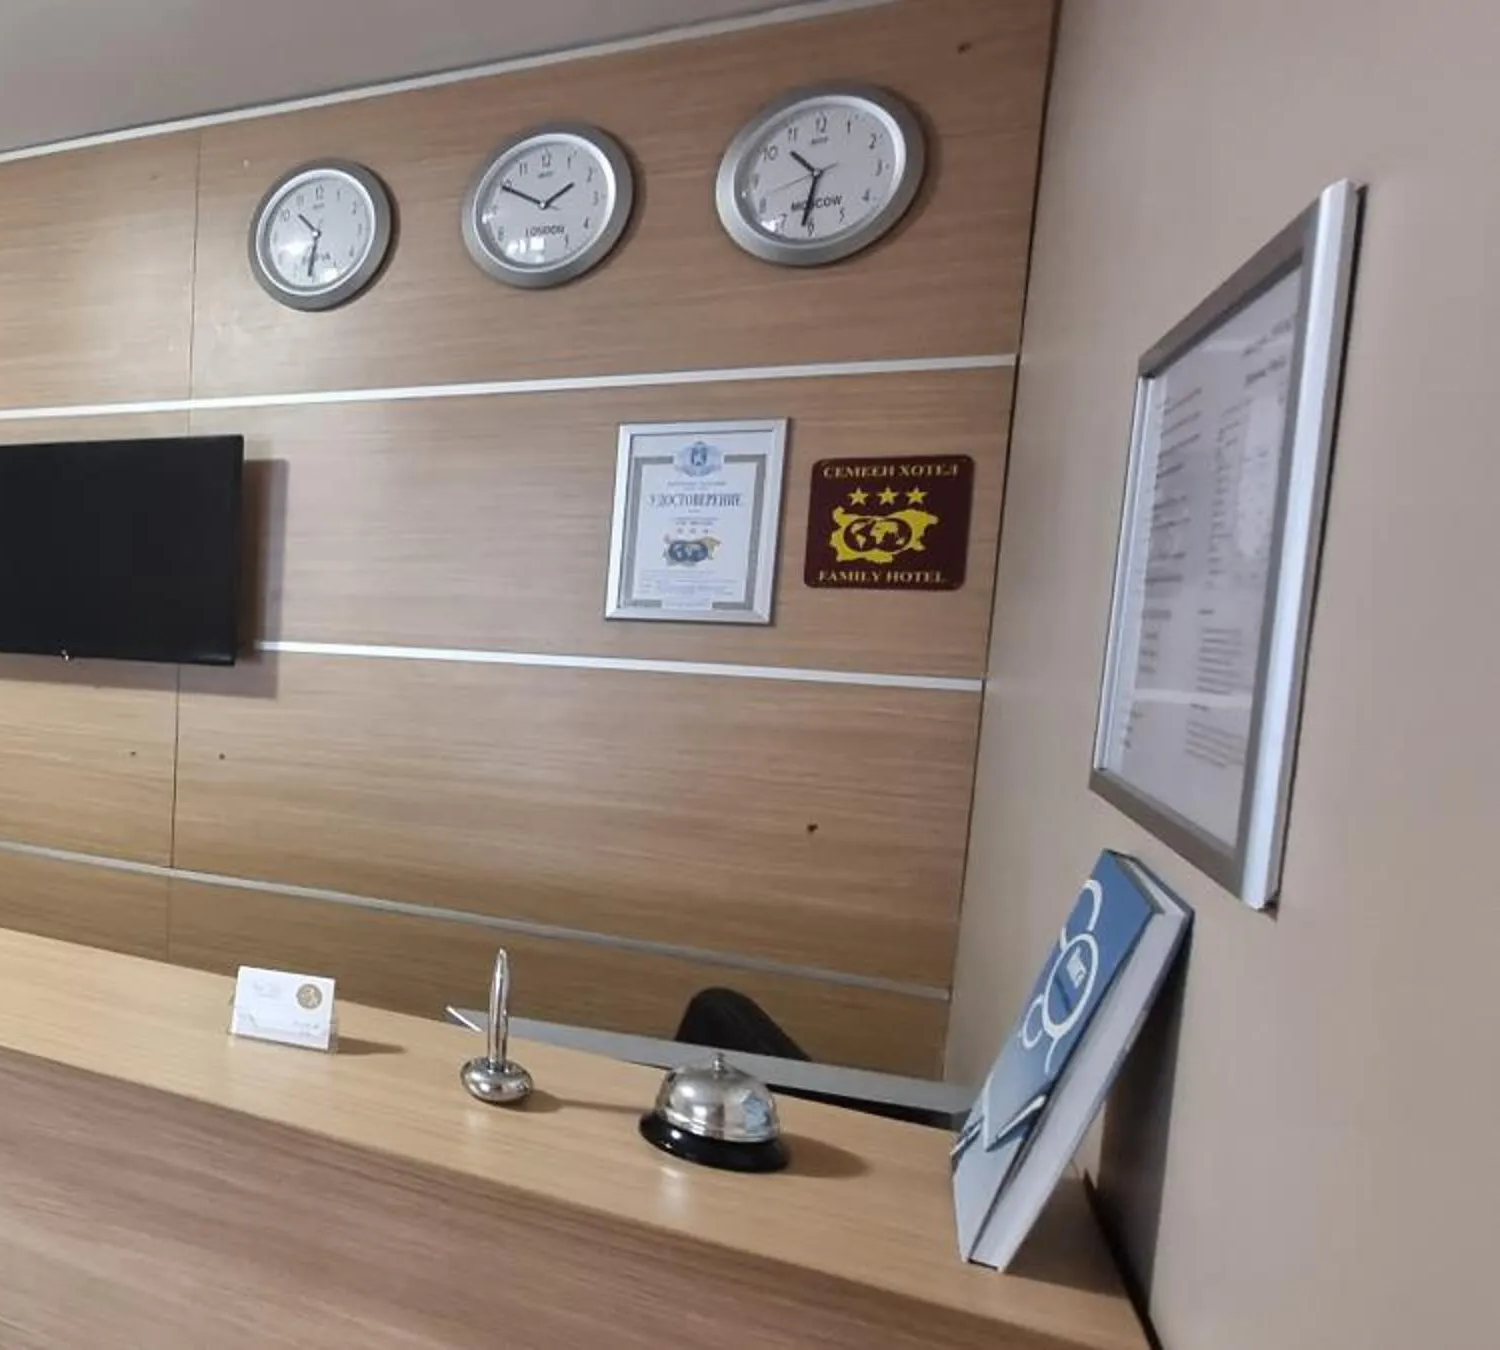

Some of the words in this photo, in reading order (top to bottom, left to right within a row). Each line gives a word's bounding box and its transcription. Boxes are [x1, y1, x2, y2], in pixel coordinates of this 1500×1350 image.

[815, 111, 828, 134] 12
[788, 127, 798, 142] 11
[868, 133, 878, 150] 2
[541, 148, 553, 169] 12
[763, 145, 779, 161] 10
[315, 184, 325, 200] 12
[791, 195, 843, 212] MOCOW
[525, 223, 565, 237] LONDON
[823, 465, 895, 479] СЕМЕЕН
[899, 463, 959, 477] ХОТЕЛ
[818, 569, 880, 582] FAMILY
[885, 571, 943, 583] HOTEL
